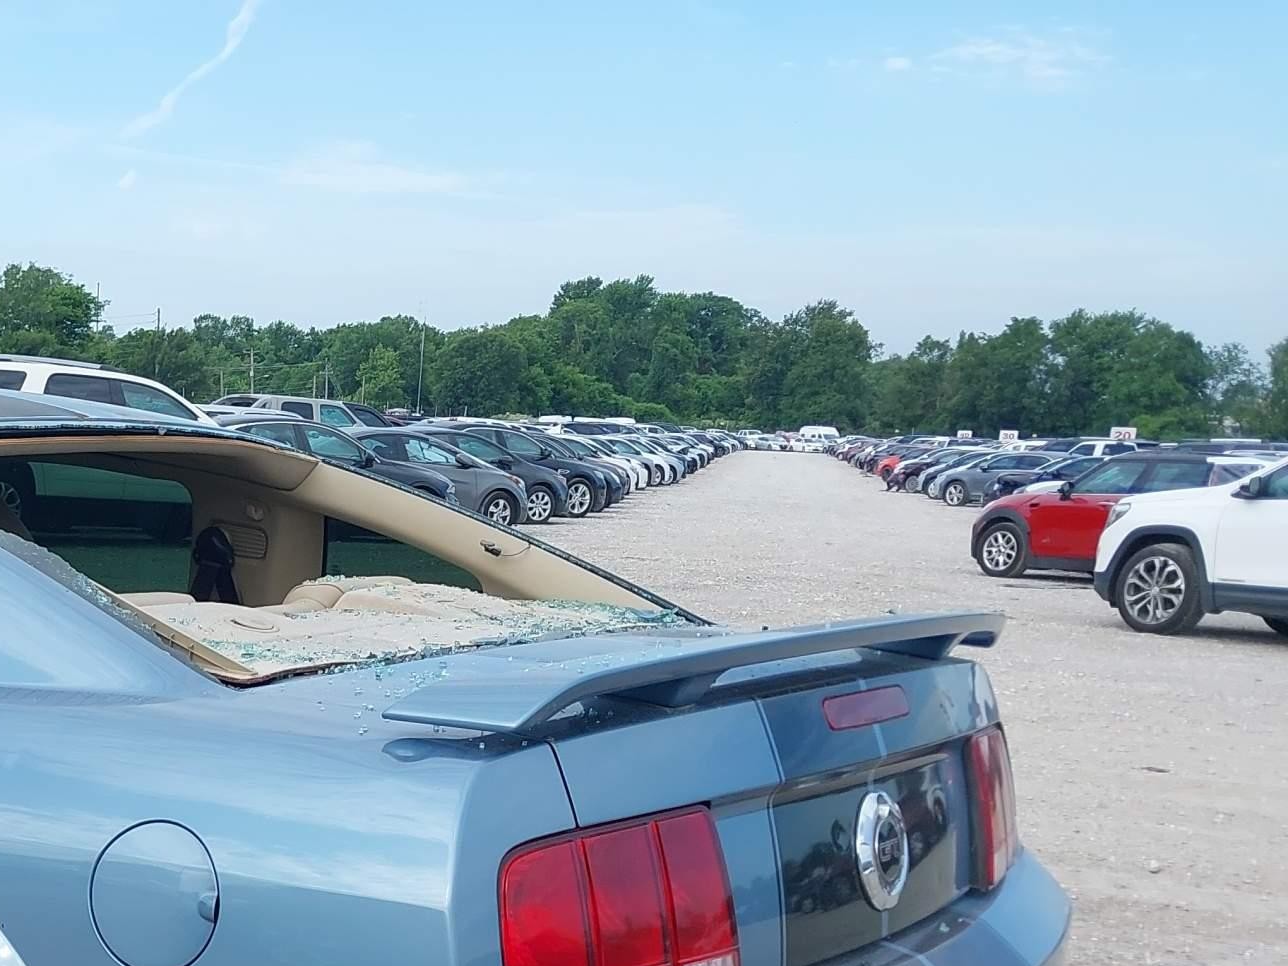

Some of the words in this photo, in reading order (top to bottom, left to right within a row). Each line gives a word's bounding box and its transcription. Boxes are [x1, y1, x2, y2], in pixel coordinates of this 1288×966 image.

[1001, 432, 1015, 440] 30
[1114, 432, 1131, 440] 20
[880, 837, 898, 862] GT
